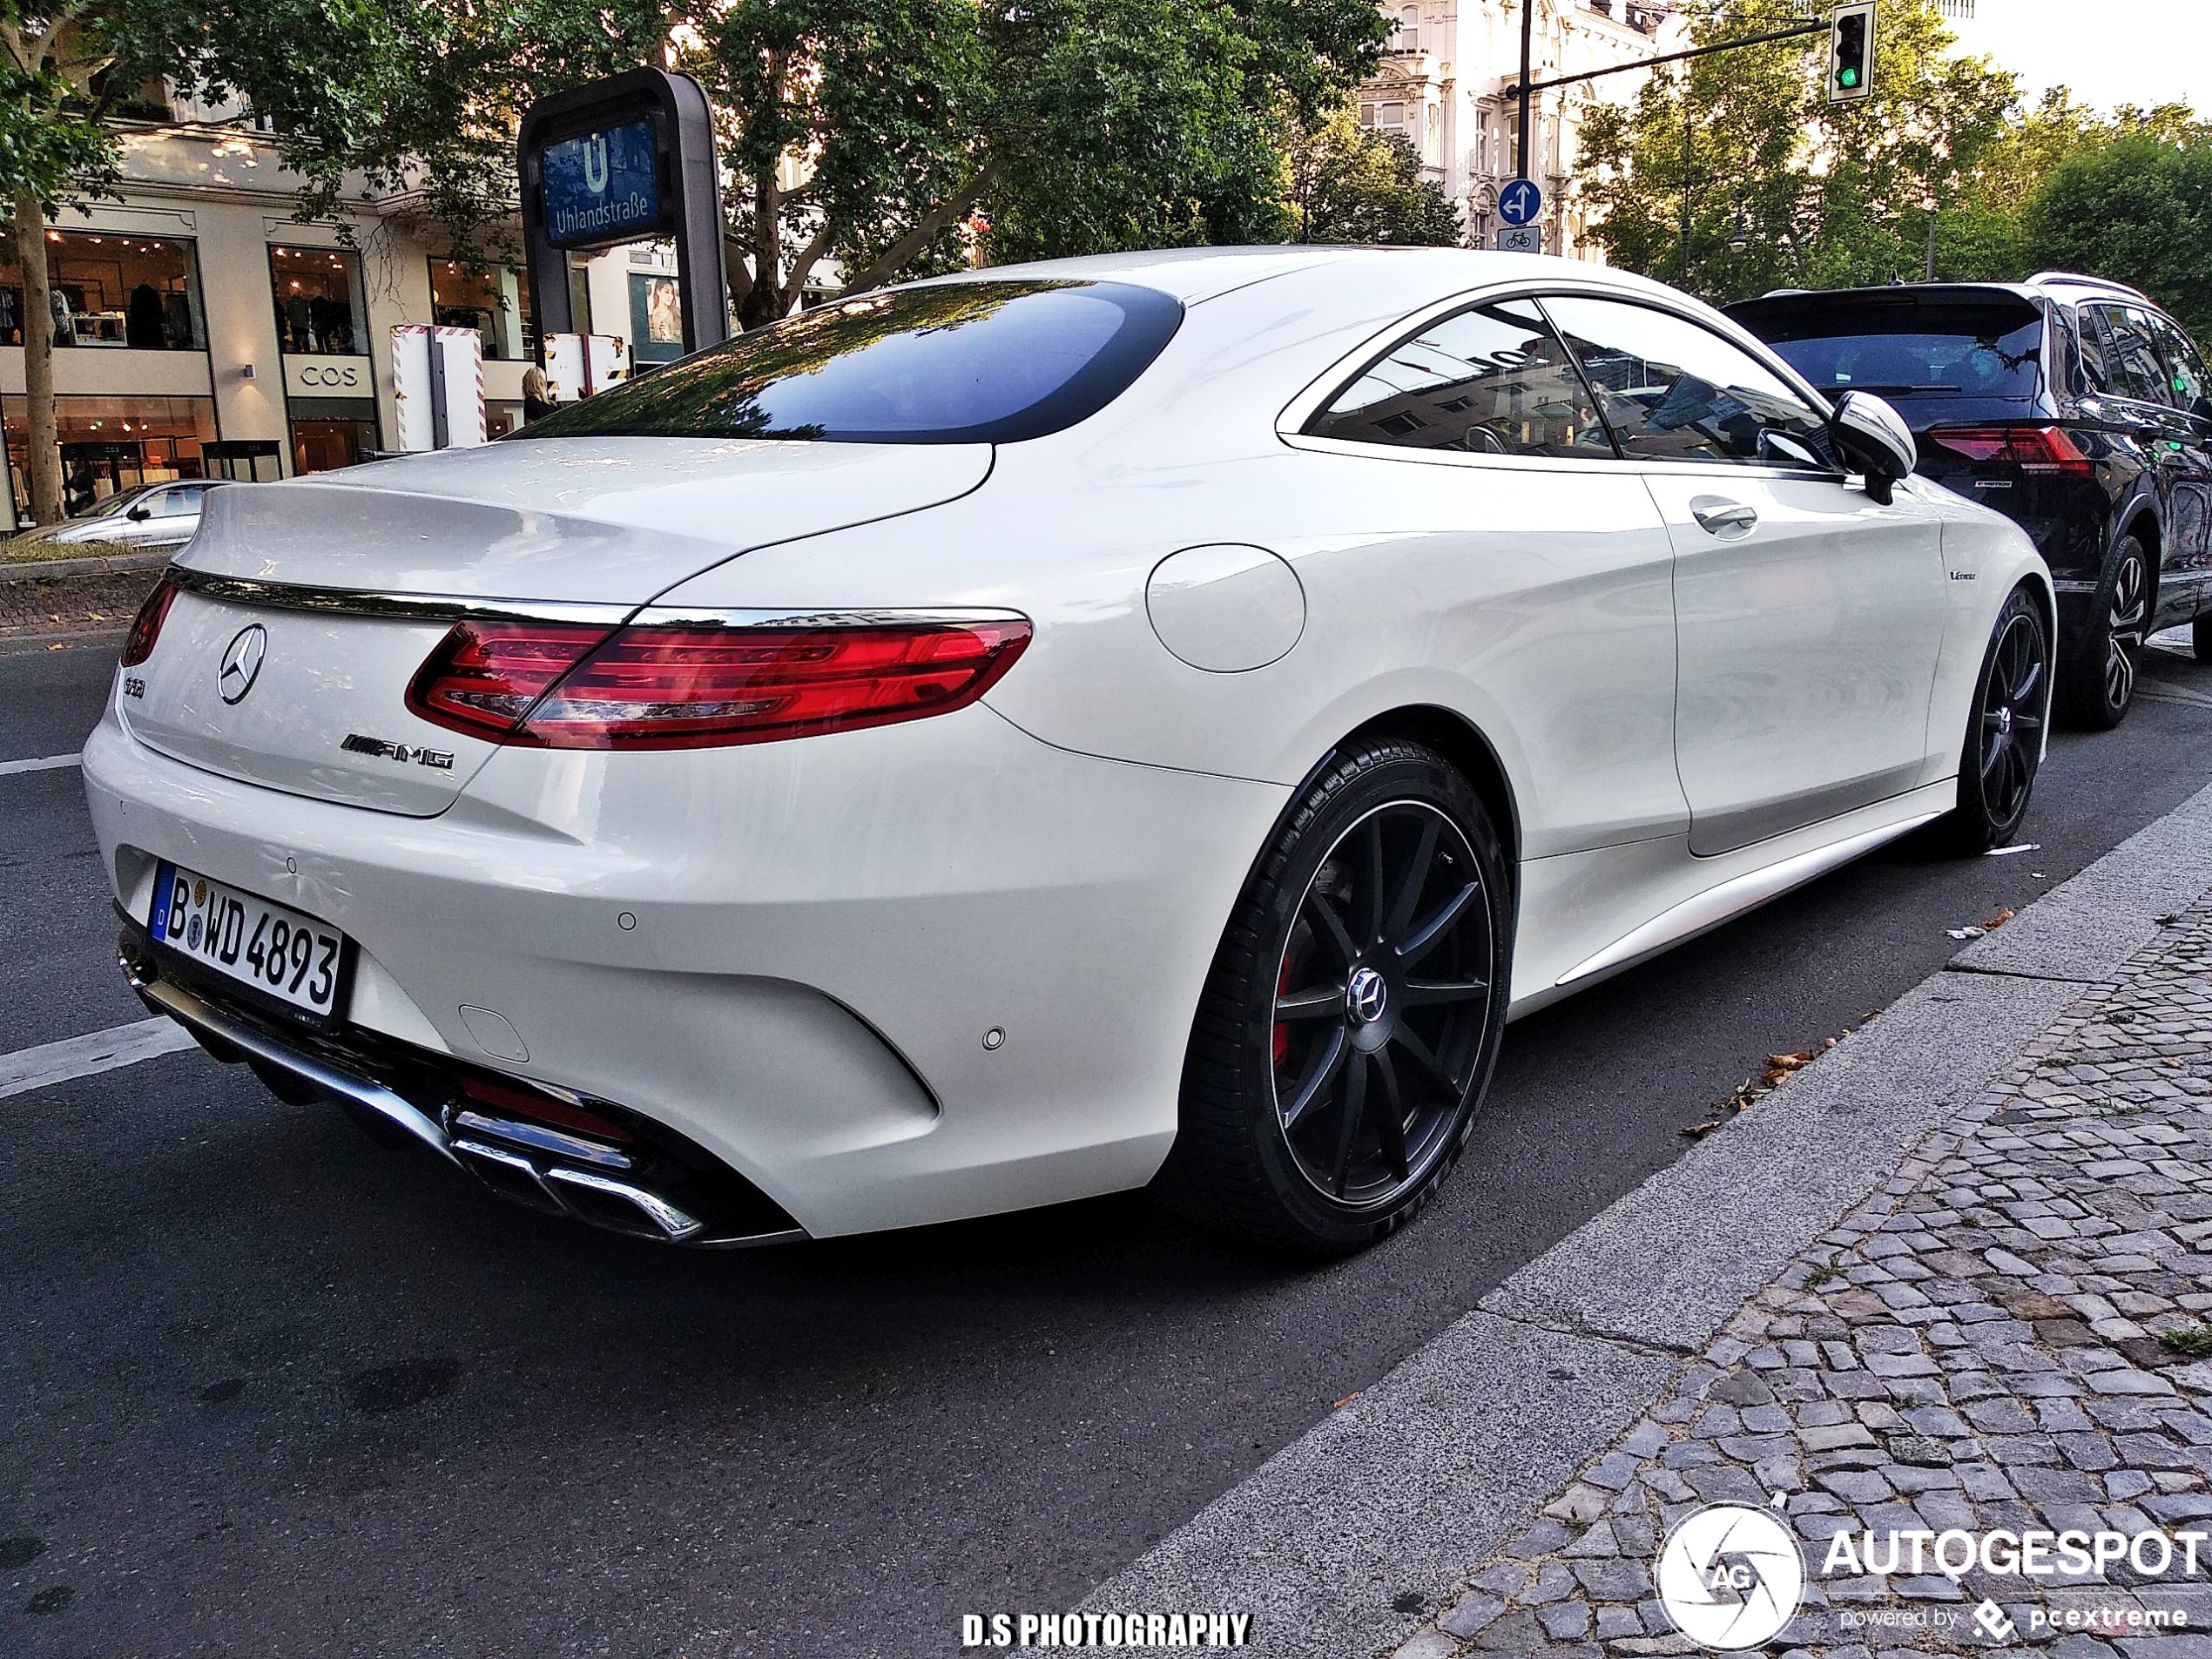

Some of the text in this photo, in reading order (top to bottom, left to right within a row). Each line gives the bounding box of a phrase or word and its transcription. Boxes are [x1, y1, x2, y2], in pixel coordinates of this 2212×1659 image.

[583, 138, 608, 193] U
[556, 192, 648, 233] Uhlandstraße
[300, 366, 359, 387] COS
[376, 739, 455, 769] AMG
[158, 908, 165, 926] D
[167, 876, 190, 940] B
